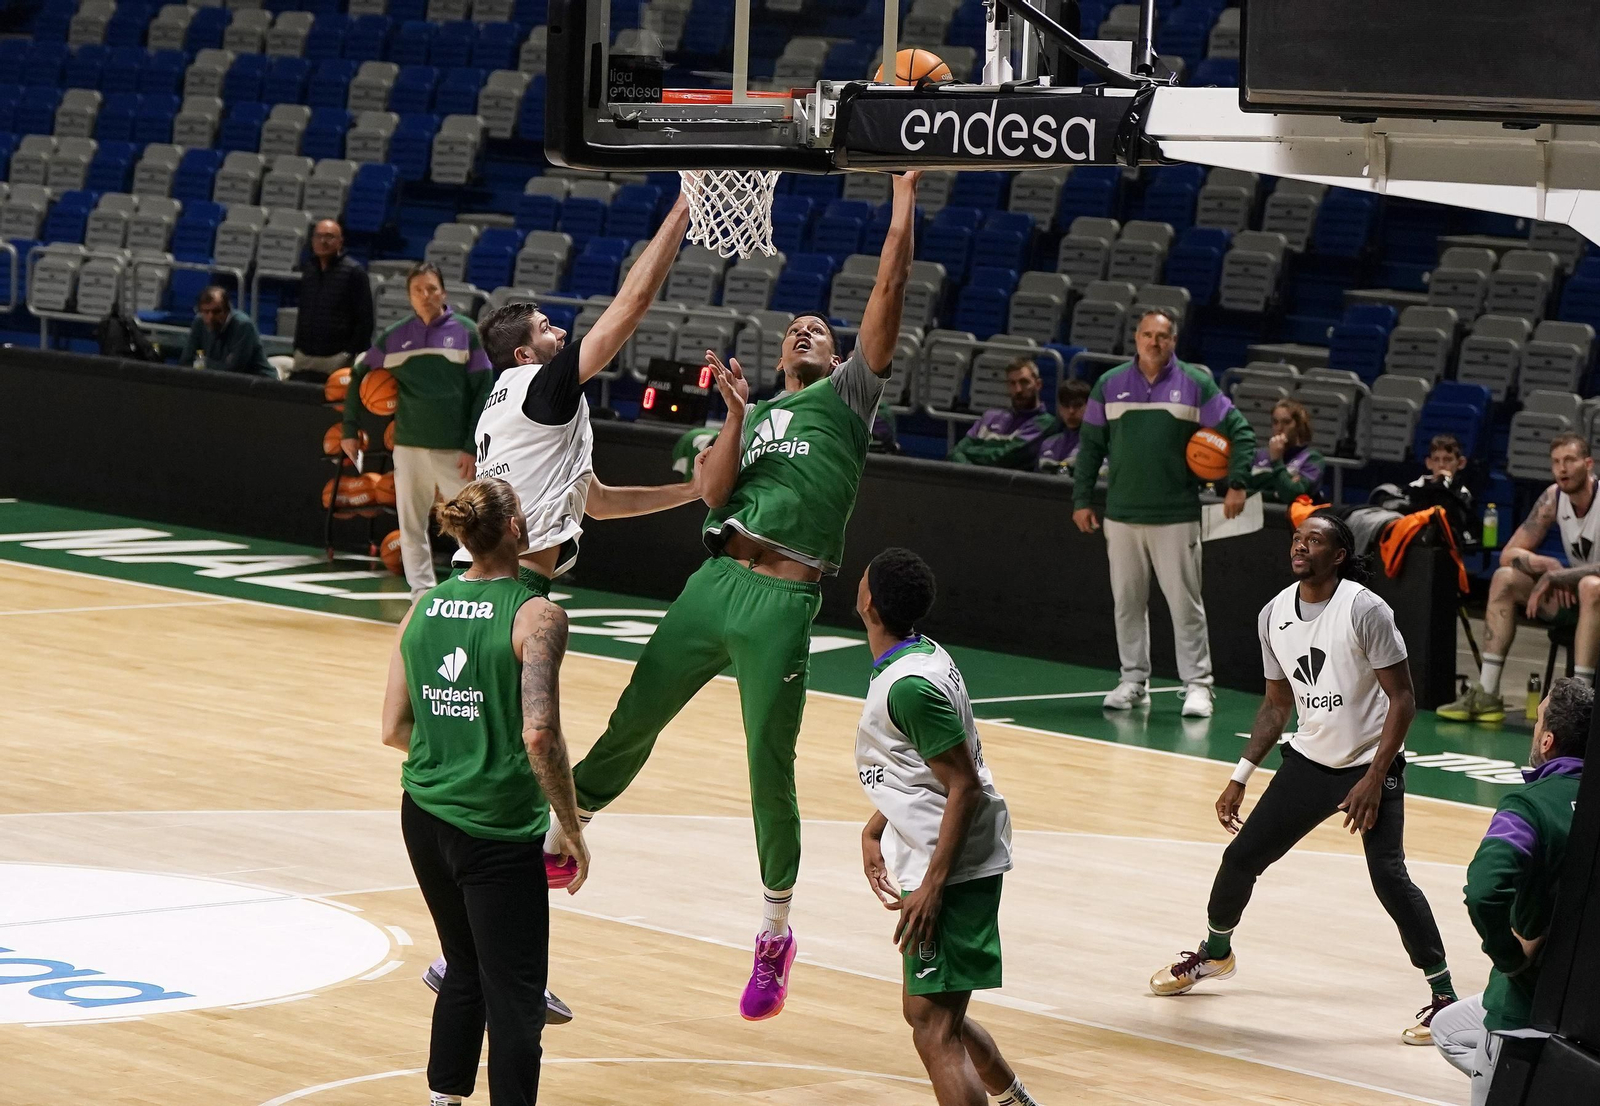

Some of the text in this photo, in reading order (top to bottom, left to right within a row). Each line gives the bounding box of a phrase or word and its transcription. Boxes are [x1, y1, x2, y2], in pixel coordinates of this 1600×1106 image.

[610, 68, 633, 85] liga
[609, 83, 660, 98] endesa
[900, 98, 1096, 161] endesa
[698, 366, 711, 389] 0
[642, 387, 656, 409] 0
[425, 598, 494, 619] Joma
[422, 685, 484, 702] Fundacin
[859, 763, 885, 789] caja
